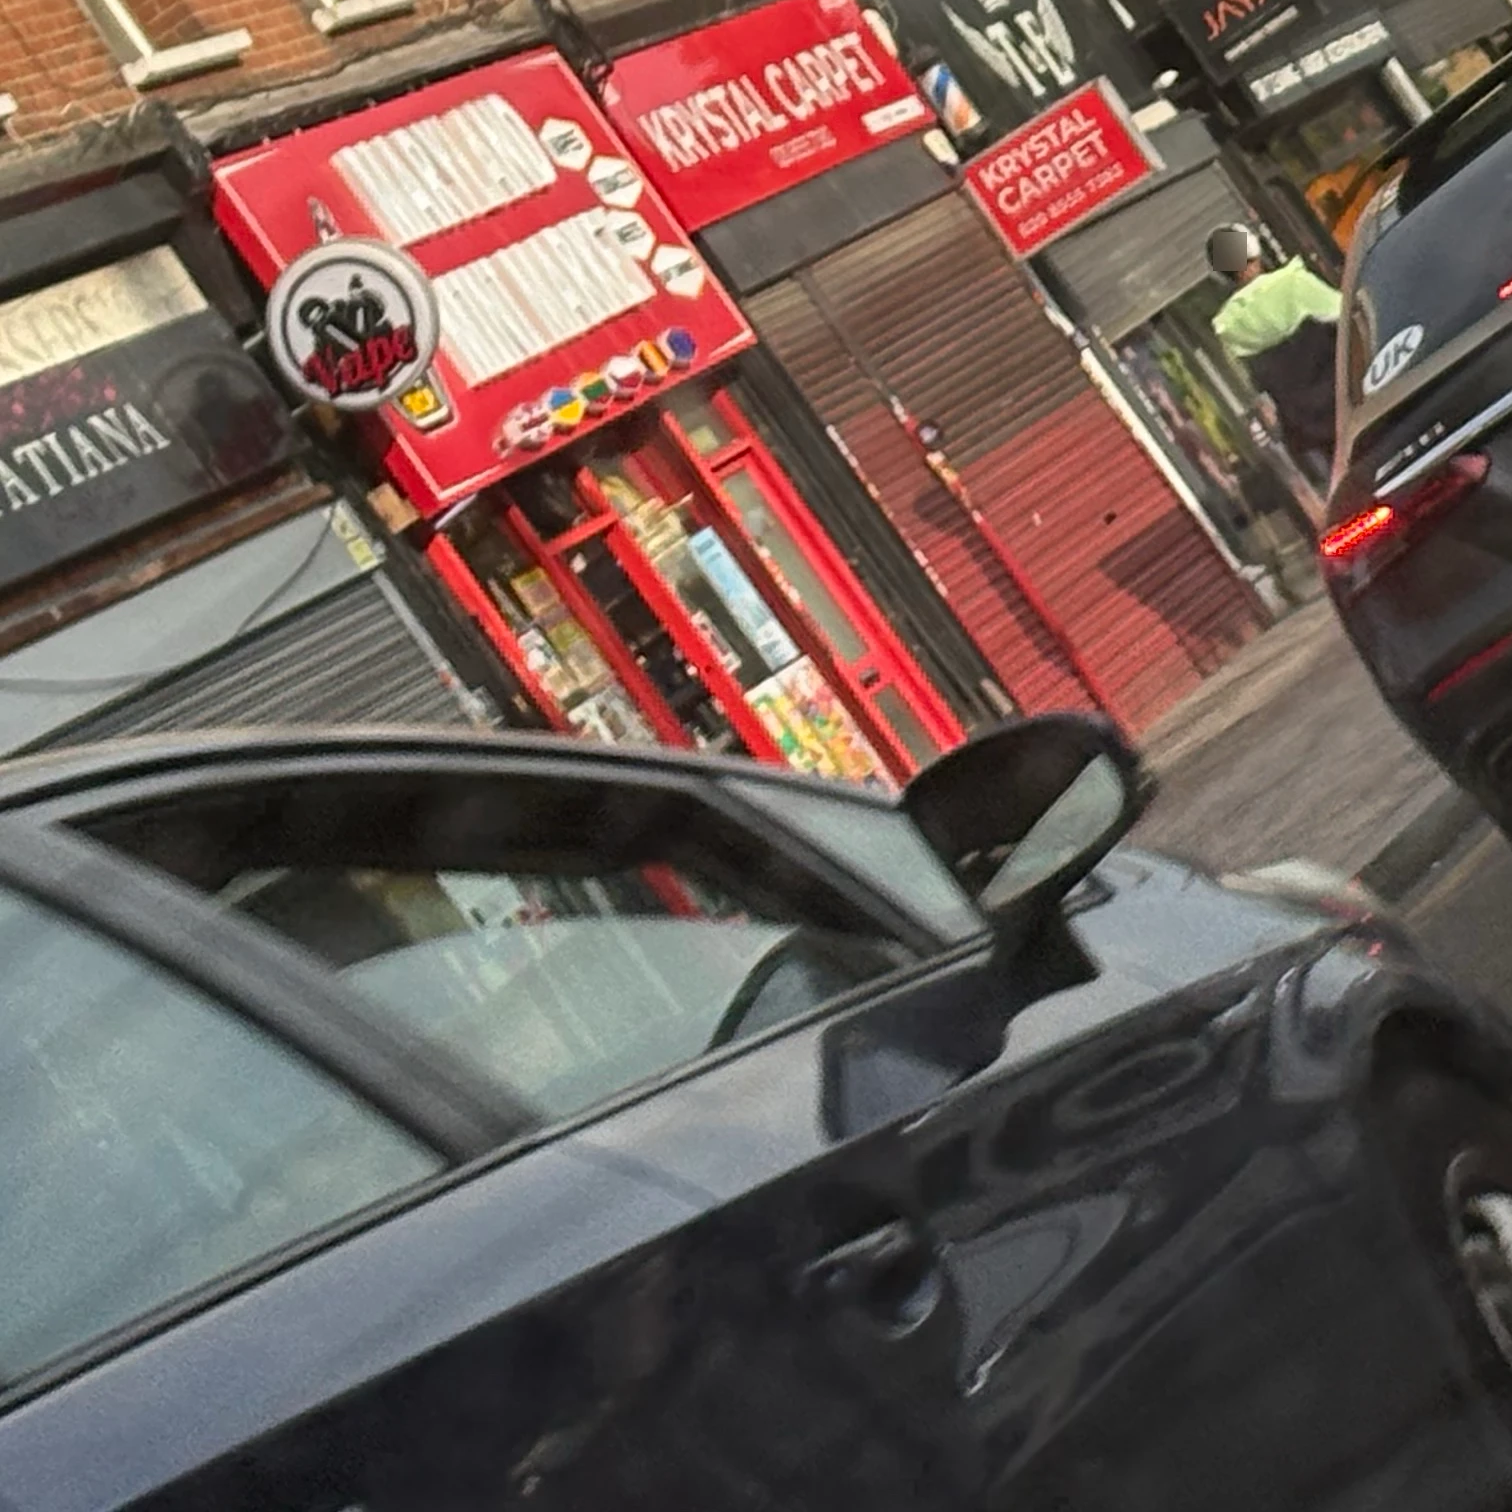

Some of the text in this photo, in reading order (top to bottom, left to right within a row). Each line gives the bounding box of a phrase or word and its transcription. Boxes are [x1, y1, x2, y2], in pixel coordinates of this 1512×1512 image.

[636, 73, 790, 174] KRYSTAL
[763, 30, 888, 122] CARPET
[977, 108, 1098, 191] KRYSTAL
[996, 127, 1109, 216] CARPET
[302, 325, 418, 399] Vape
[1370, 326, 1416, 387] UK
[0, 402, 171, 516] ATIANA
